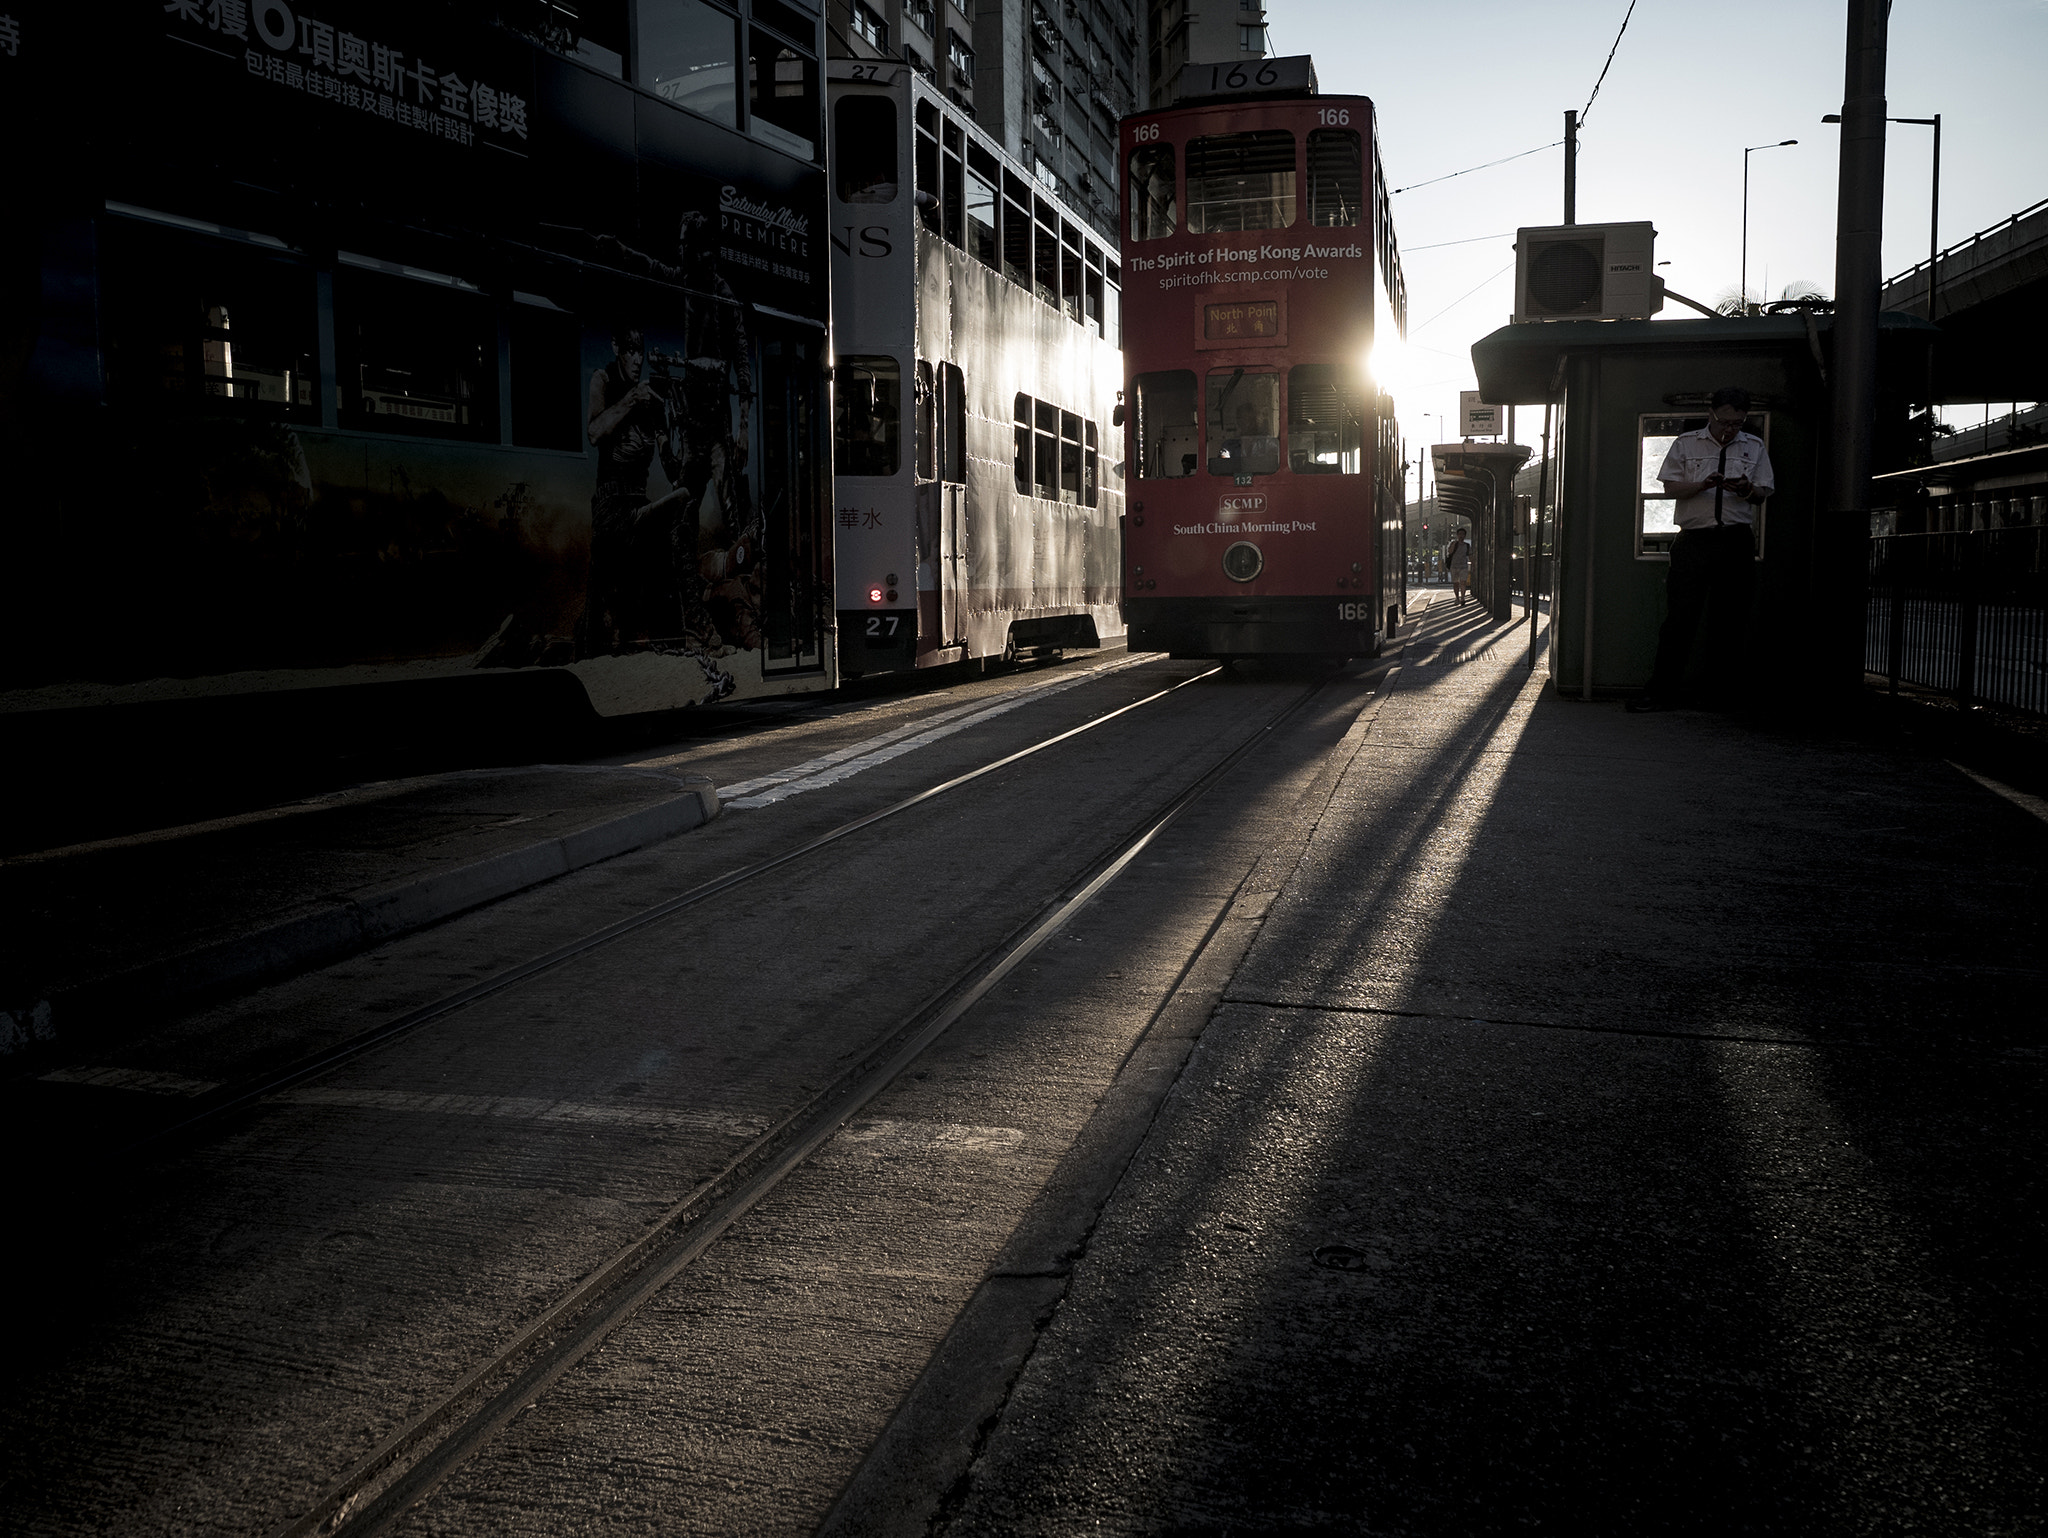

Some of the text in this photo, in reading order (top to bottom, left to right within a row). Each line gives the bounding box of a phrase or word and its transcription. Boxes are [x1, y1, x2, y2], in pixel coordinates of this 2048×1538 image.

[852, 65, 879, 80] 27
[1211, 61, 1278, 91] 166
[244, 47, 476, 148] 包括最佳剪接及最佳製作設計
[1317, 109, 1350, 126] 166
[1132, 123, 1160, 143] 166
[720, 185, 808, 235] Saturday Night
[721, 214, 808, 258] PREMIERE
[1130, 244, 1362, 272] The Spirit of Hong Kong Awards
[1159, 266, 1329, 290] spiritofhk.scmp.com/vote
[1210, 306, 1277, 321] North Point
[1226, 320, 1264, 335] 北角
[1235, 476, 1252, 485] 132
[1223, 498, 1263, 510] SCMP
[838, 507, 882, 530] 華水
[1173, 520, 1317, 536] South China Morning Post
[1338, 603, 1368, 621] 166
[865, 616, 899, 636] 27
